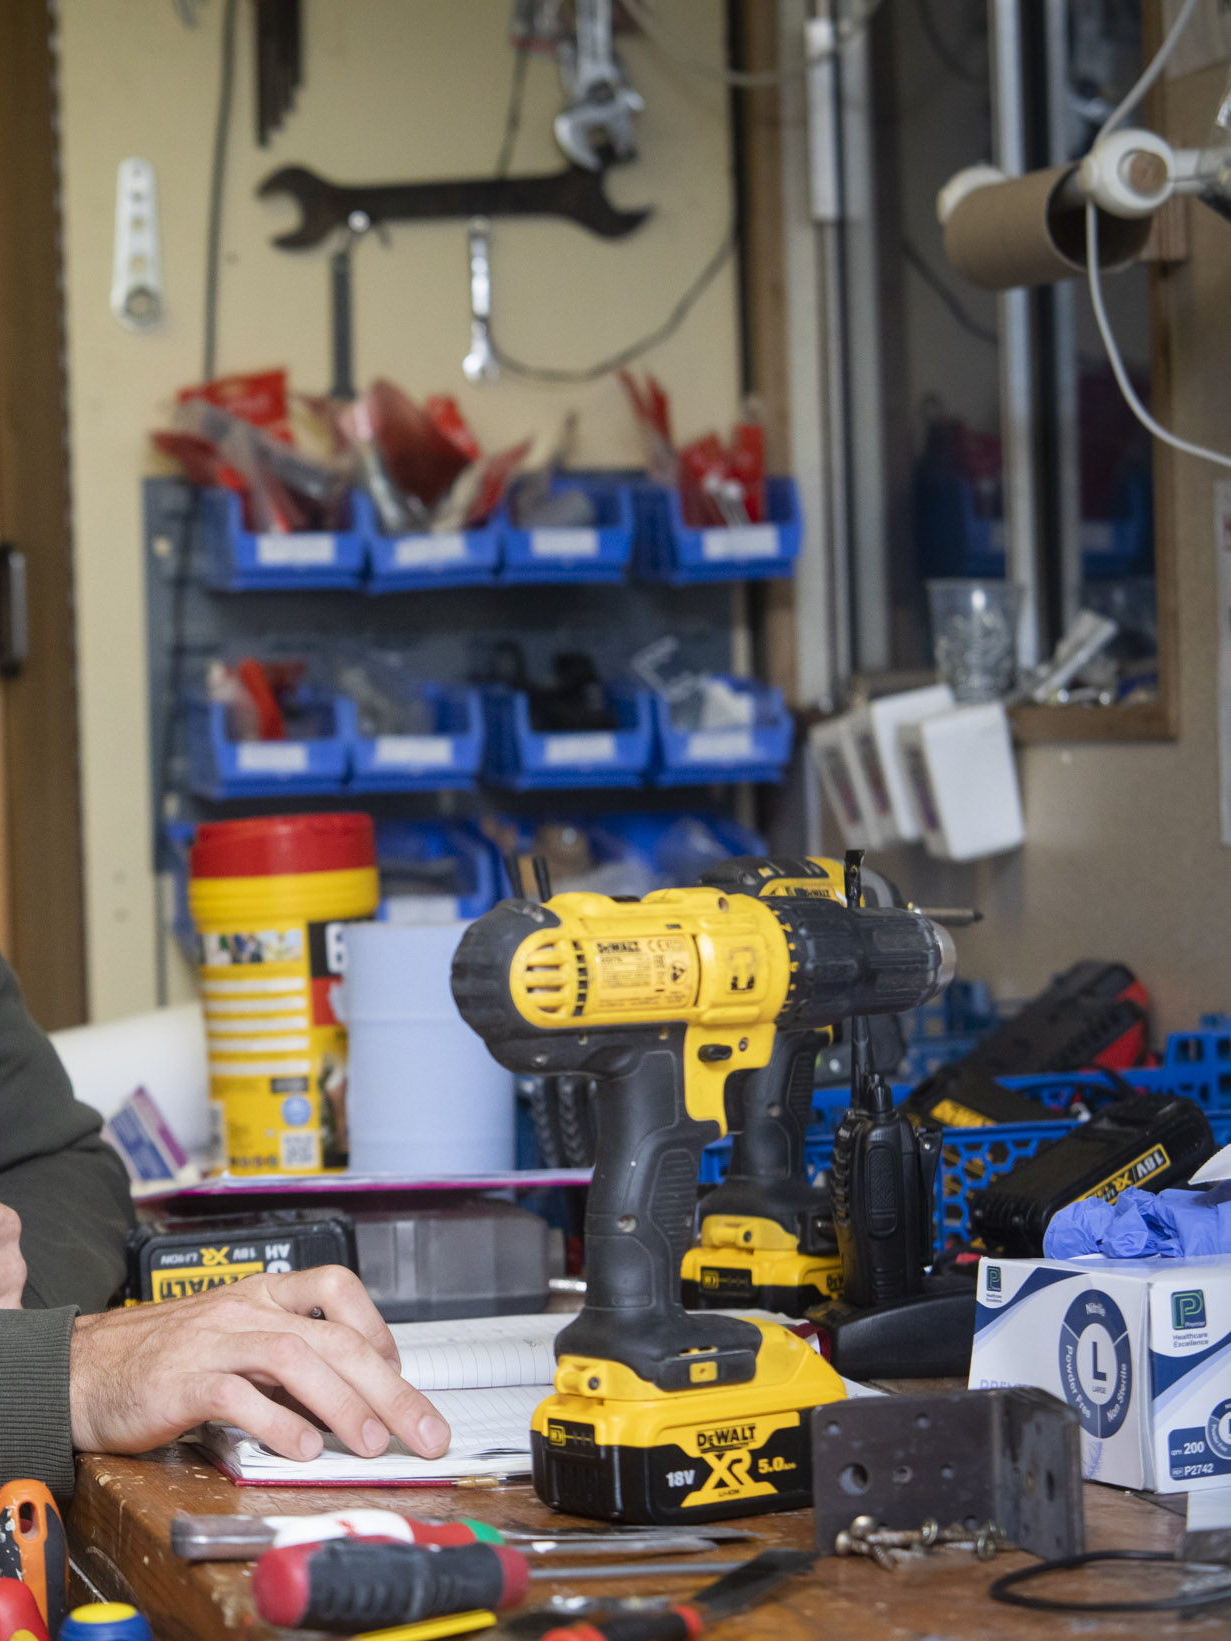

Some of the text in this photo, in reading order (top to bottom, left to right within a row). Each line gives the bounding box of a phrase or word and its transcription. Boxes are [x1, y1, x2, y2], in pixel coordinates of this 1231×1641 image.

[1137, 1152, 1164, 1178] 18V
[200, 1246, 229, 1266] XR
[265, 1243, 290, 1260] AH
[1085, 1303, 1106, 1317] Nitrile
[1172, 1333, 1208, 1341] Healthcare
[1173, 1340, 1208, 1348] Excellence
[1091, 1341, 1107, 1382] L
[1066, 1345, 1091, 1419] Powder Free
[1106, 1363, 1128, 1422] Non Sterile
[1183, 1441, 1205, 1455] 200
[666, 1469, 696, 1488] 18V
[1183, 1463, 1214, 1477] P2742
